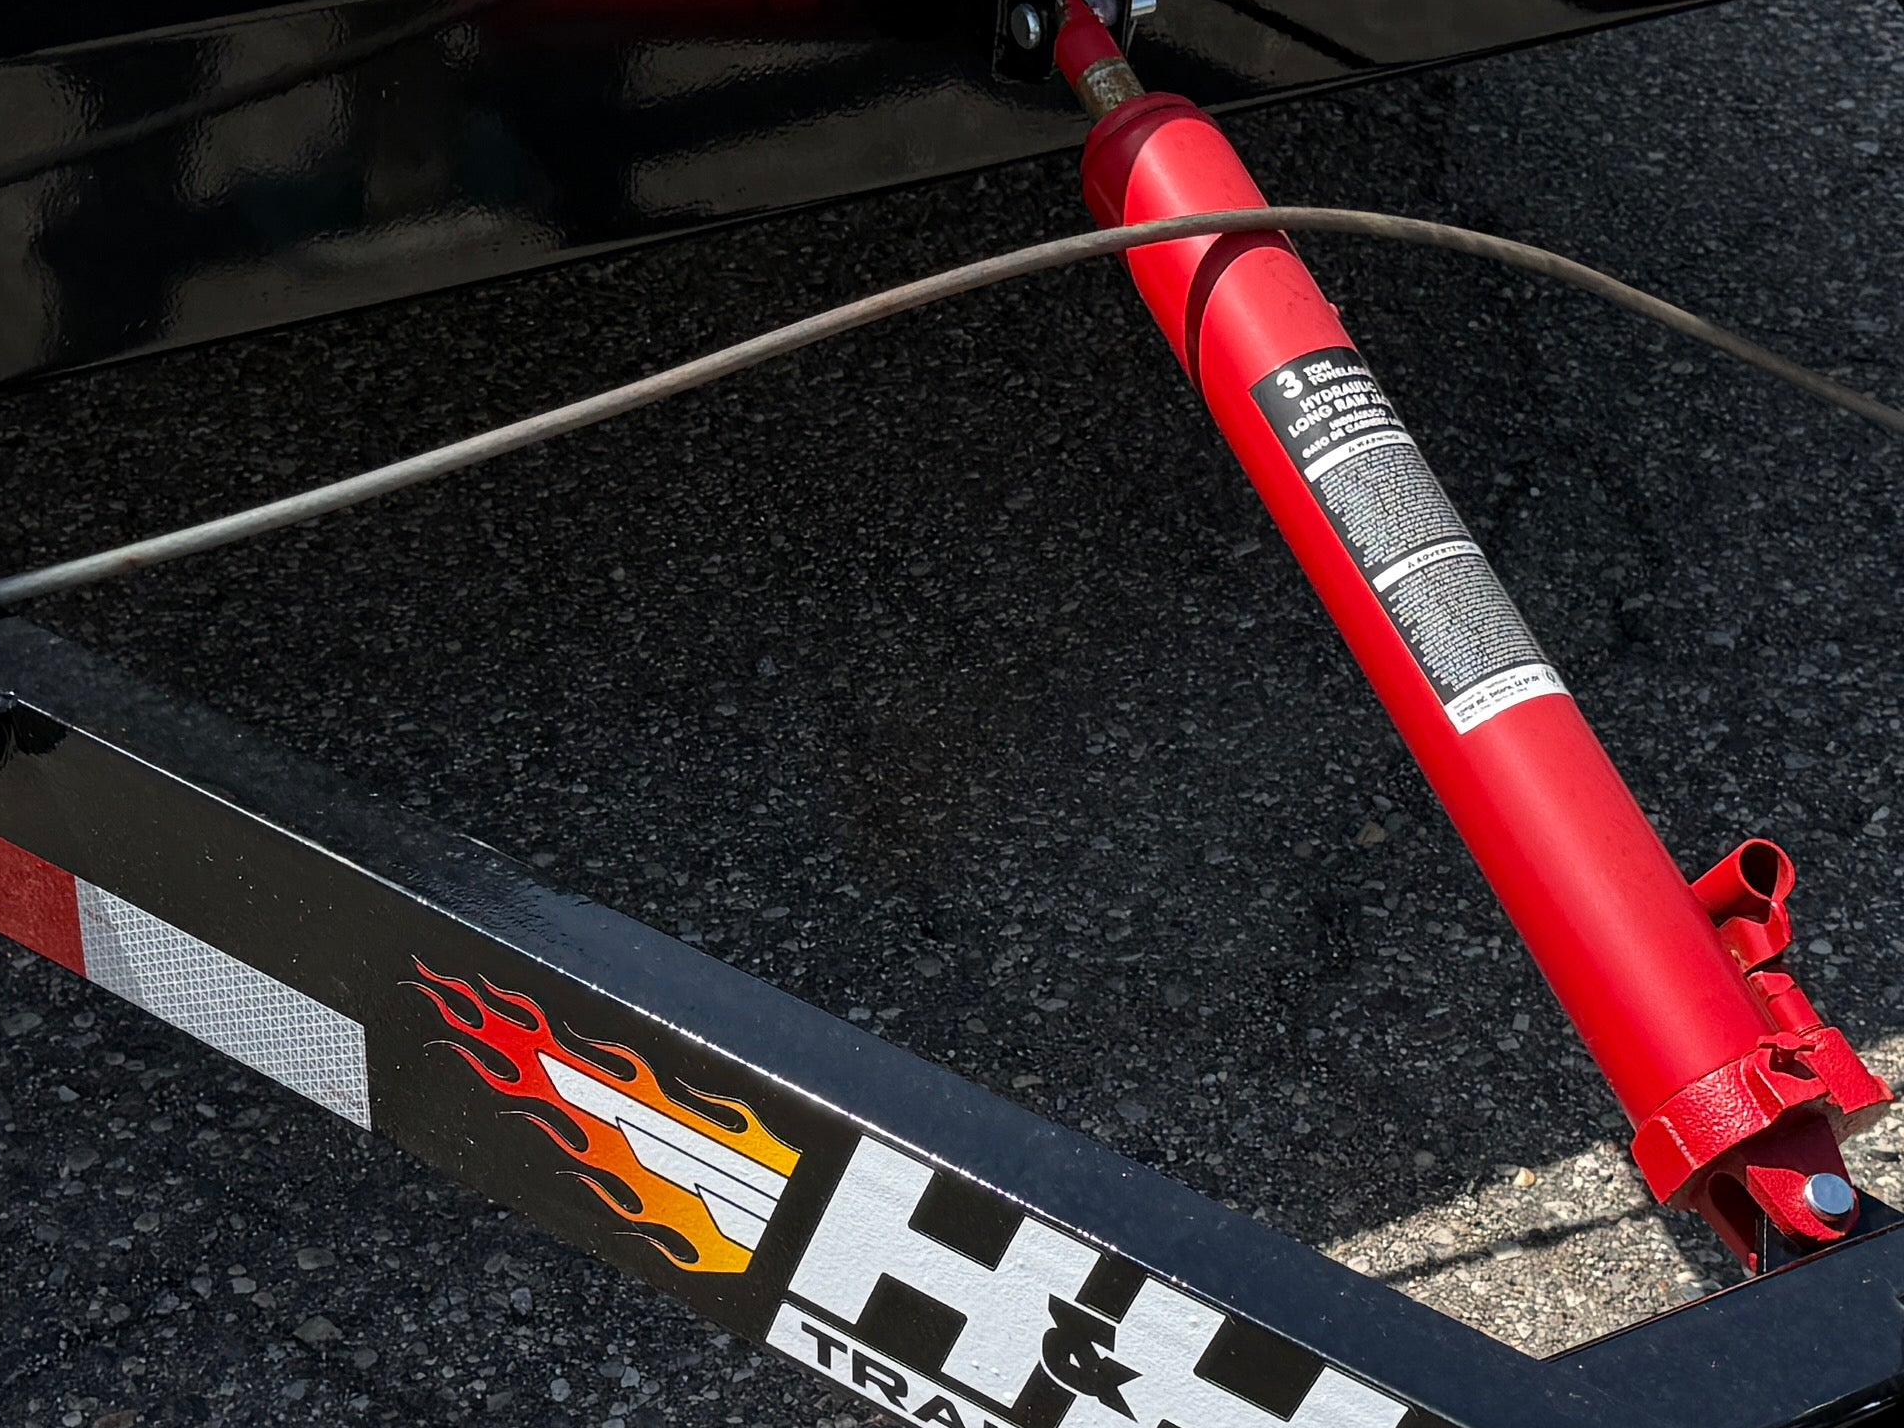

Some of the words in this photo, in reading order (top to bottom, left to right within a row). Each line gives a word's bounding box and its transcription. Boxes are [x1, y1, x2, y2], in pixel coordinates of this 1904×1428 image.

[1302, 361, 1333, 377] TON
[1276, 370, 1303, 399] 3
[1300, 383, 1376, 413] HYDRAULIC
[1288, 403, 1334, 438] LONG
[1337, 395, 1368, 417] RAM
